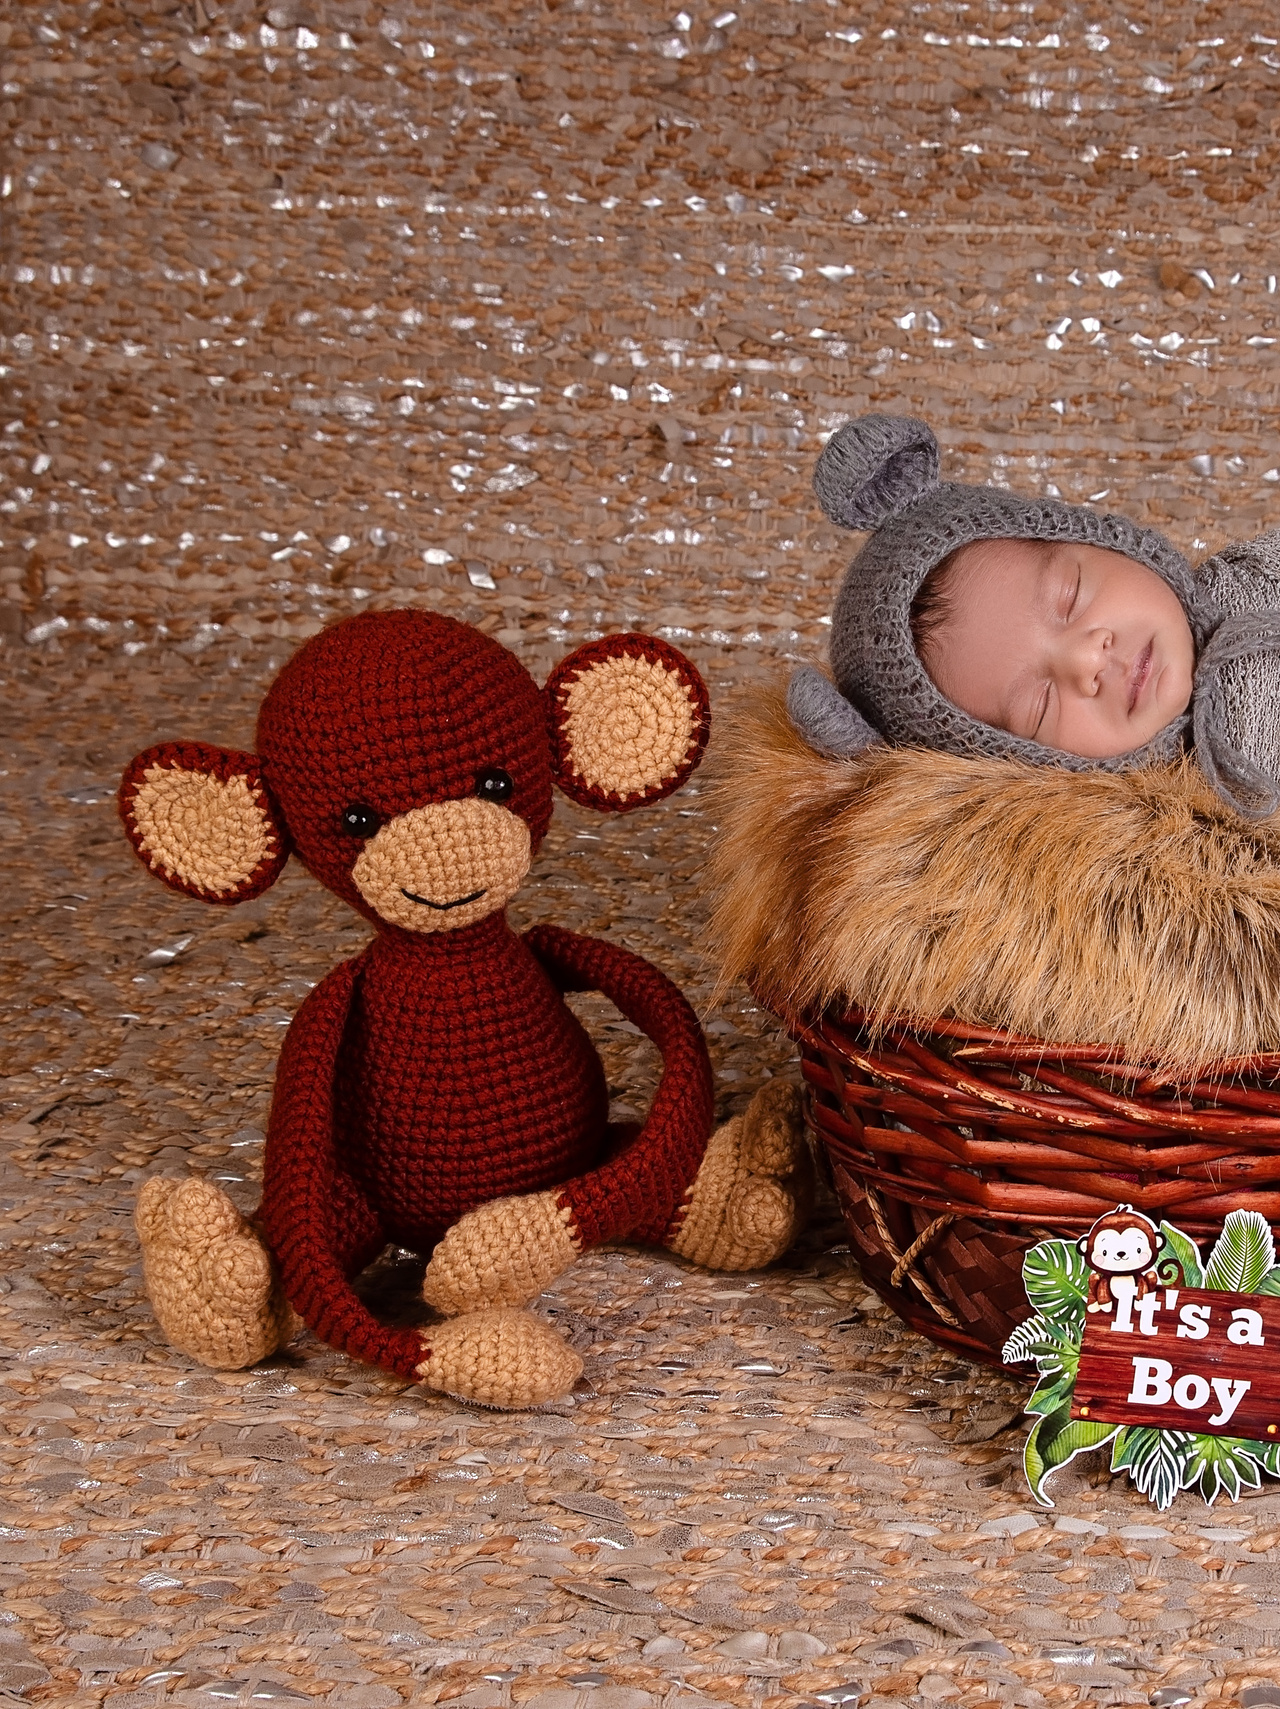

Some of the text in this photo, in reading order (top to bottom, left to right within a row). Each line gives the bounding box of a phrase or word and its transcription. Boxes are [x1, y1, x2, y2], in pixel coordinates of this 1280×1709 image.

[1110, 1286, 1265, 1346] It's a
[1127, 1356, 1251, 1426] Boy
